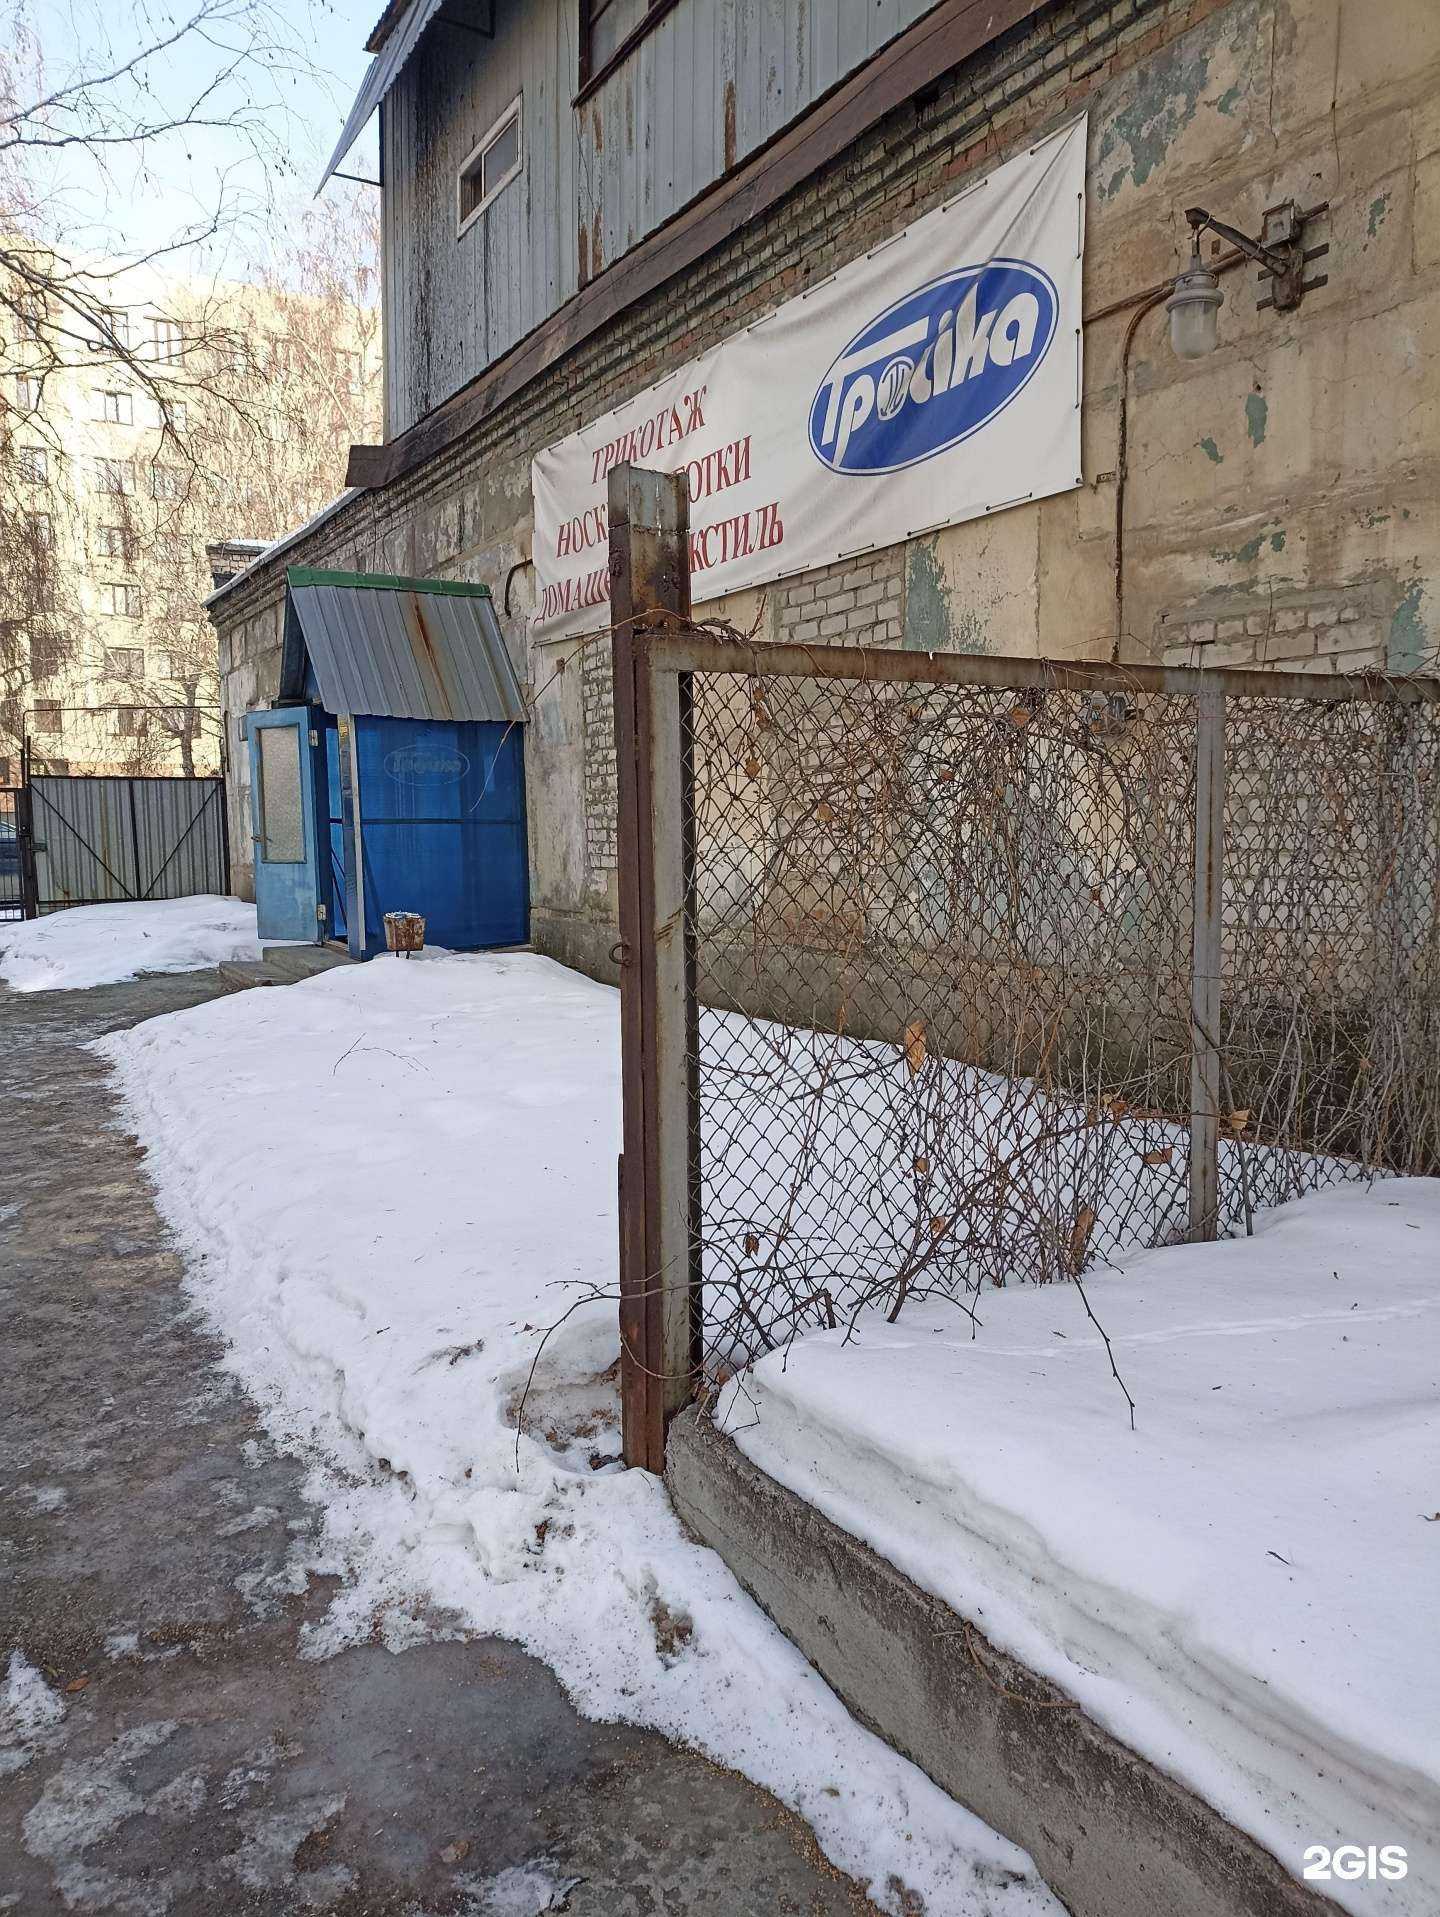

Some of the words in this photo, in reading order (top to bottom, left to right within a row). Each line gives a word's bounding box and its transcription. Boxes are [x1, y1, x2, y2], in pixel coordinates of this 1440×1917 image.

[592, 385, 707, 484] ТРИКОТАЖ
[556, 502, 609, 558] НОСК
[671, 435, 752, 503] ОТКИ
[688, 502, 783, 574] КСТИЛЬ
